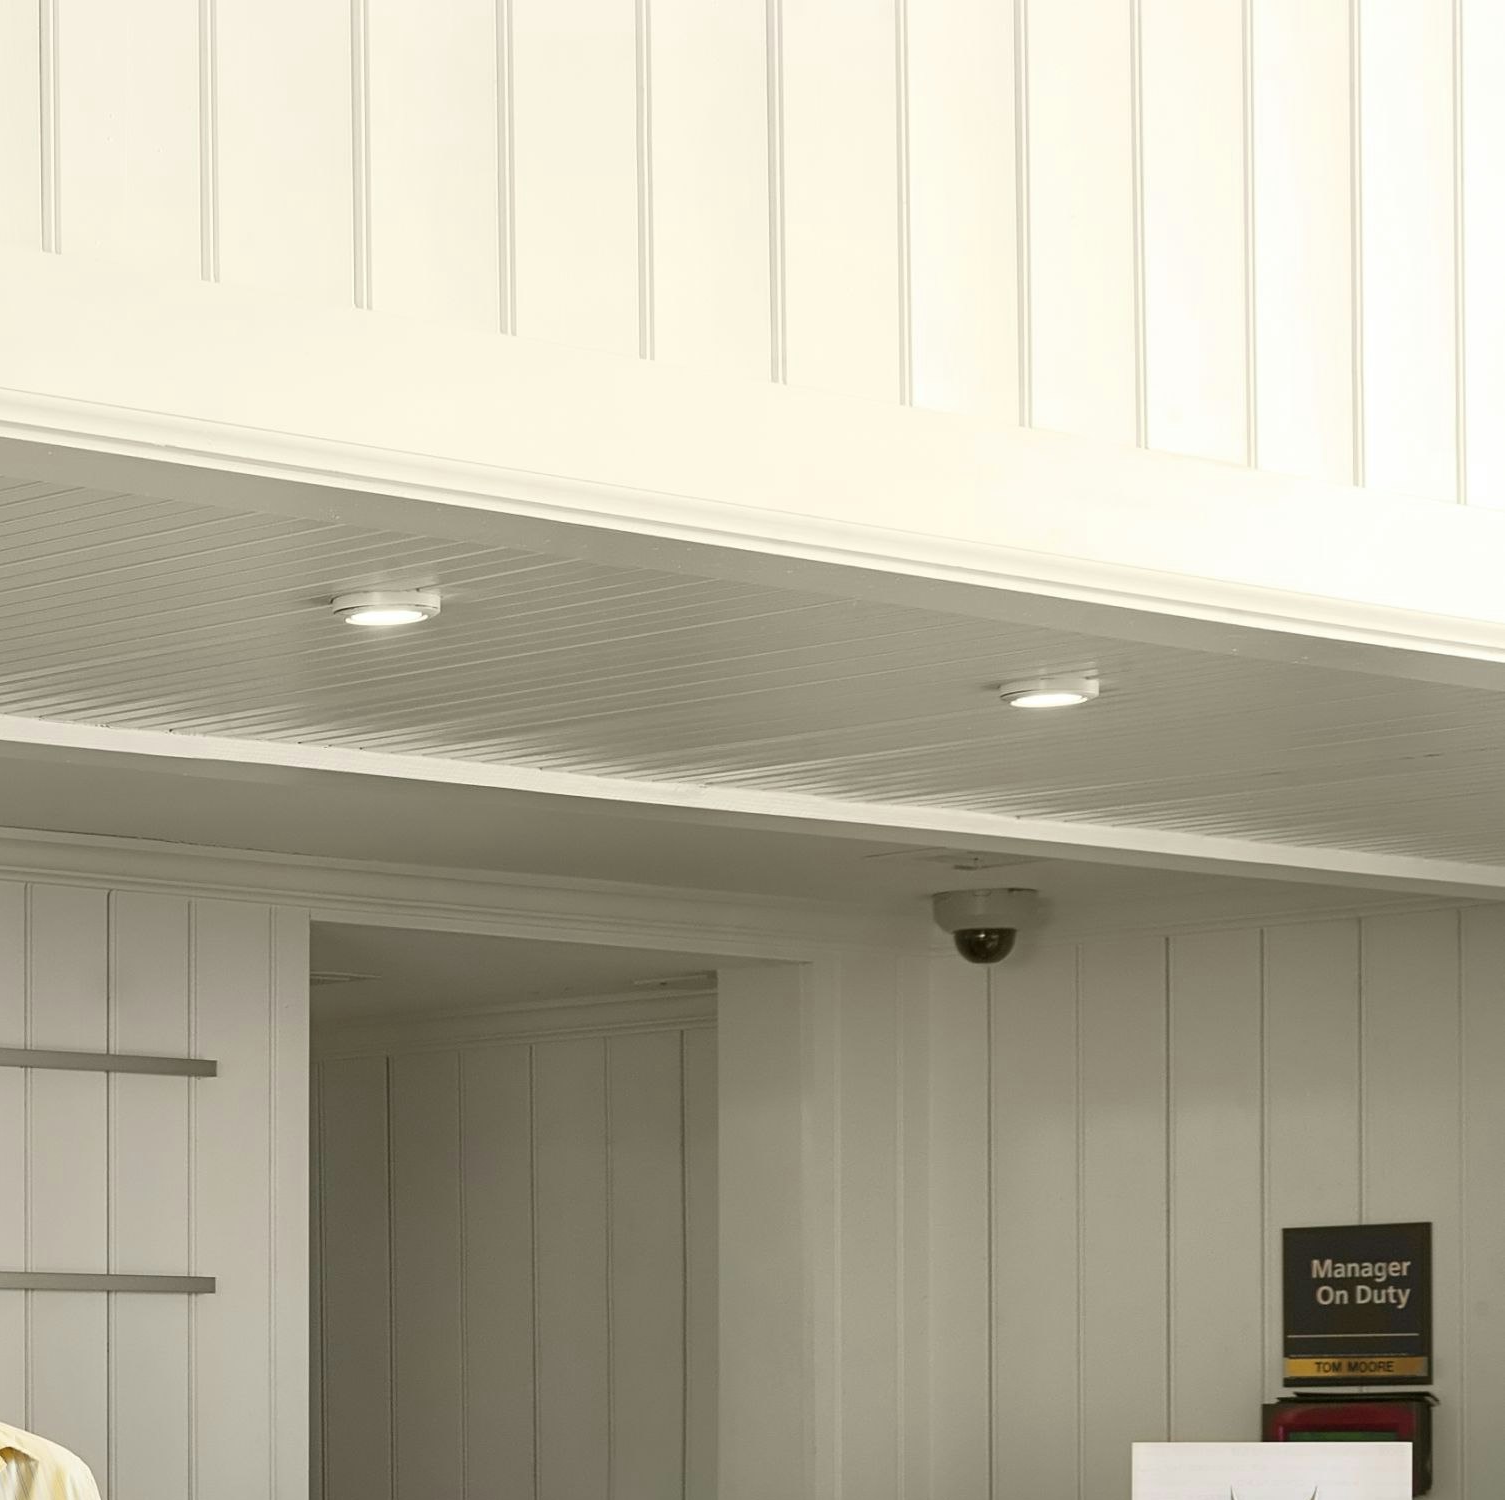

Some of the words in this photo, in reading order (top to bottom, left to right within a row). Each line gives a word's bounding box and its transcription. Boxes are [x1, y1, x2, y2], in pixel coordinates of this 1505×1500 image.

[1311, 1259, 1411, 1282] Manager
[1316, 1286, 1348, 1305] On
[1355, 1285, 1411, 1309] Duty
[1315, 1361, 1342, 1373] TOM
[1348, 1360, 1394, 1372] MOORE
